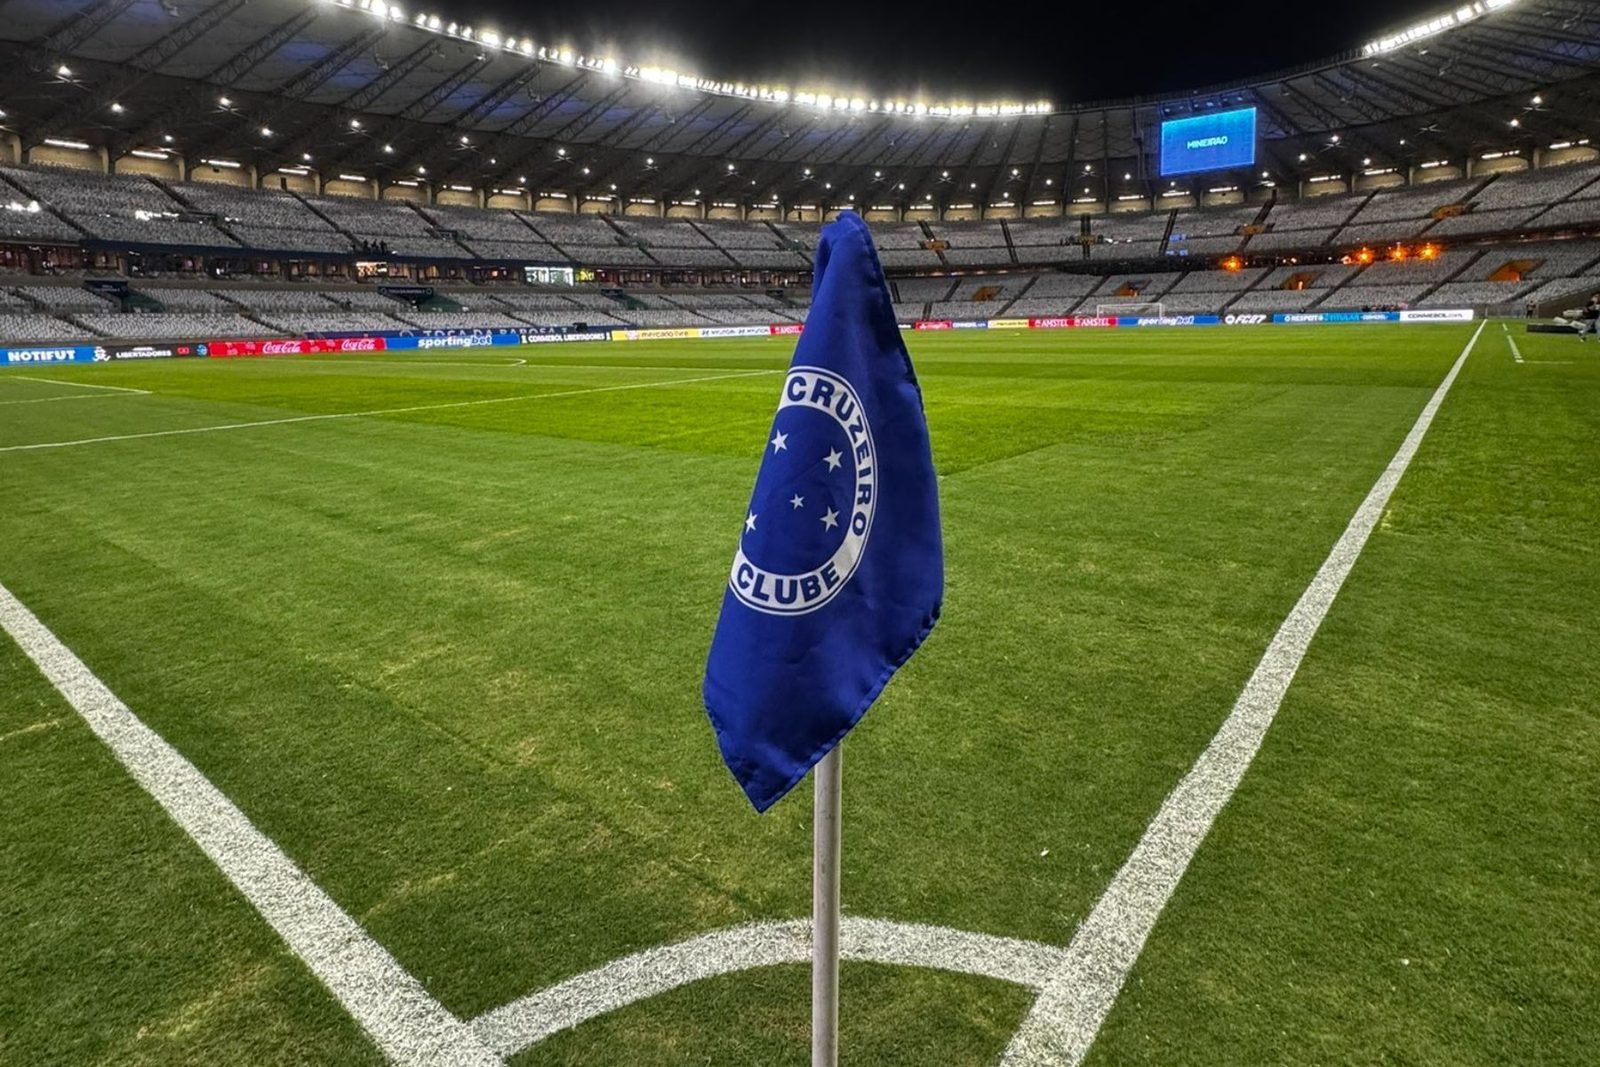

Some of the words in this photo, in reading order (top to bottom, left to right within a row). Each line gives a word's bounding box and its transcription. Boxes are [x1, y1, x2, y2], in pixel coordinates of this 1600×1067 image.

[1041, 319, 1068, 327] AMSTEL
[1081, 318, 1109, 326] AMSTEL
[418, 335, 493, 348] sportingbet
[8, 350, 75, 362] NOTIFUT
[116, 350, 171, 358] LIBERTADORES
[787, 376, 872, 537] CRUZEIRO
[737, 561, 840, 604] CLUBE
